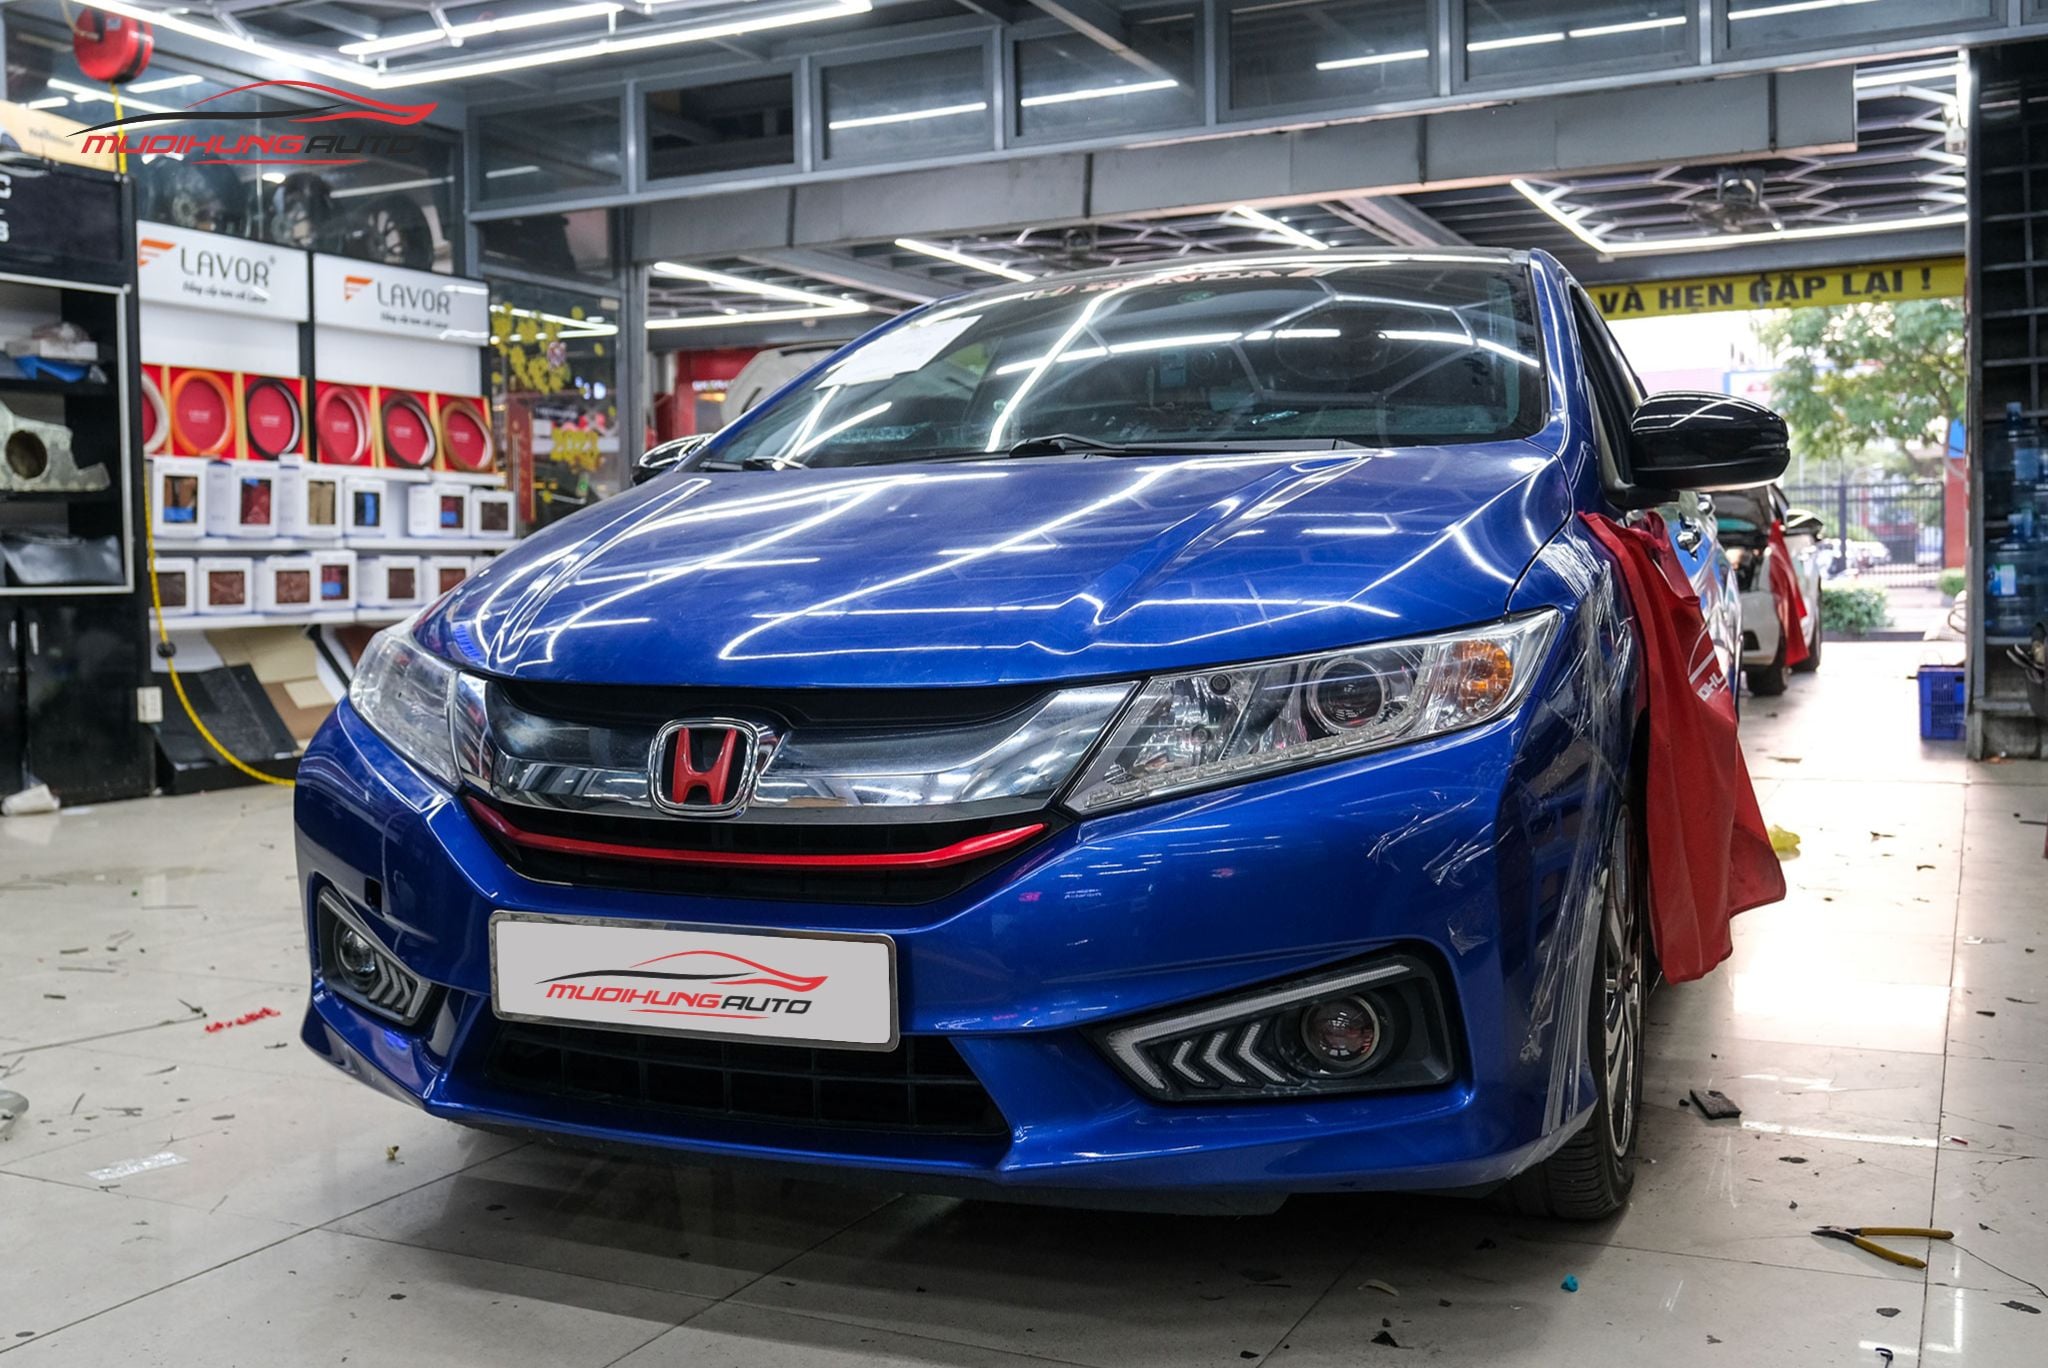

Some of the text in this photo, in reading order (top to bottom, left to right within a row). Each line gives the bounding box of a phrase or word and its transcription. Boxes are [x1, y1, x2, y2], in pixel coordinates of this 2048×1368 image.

[180, 246, 269, 287] LAVOR
[377, 281, 450, 315] LAVOR
[1599, 285, 1645, 314] VÀ
[1841, 269, 1904, 300] LẠI
